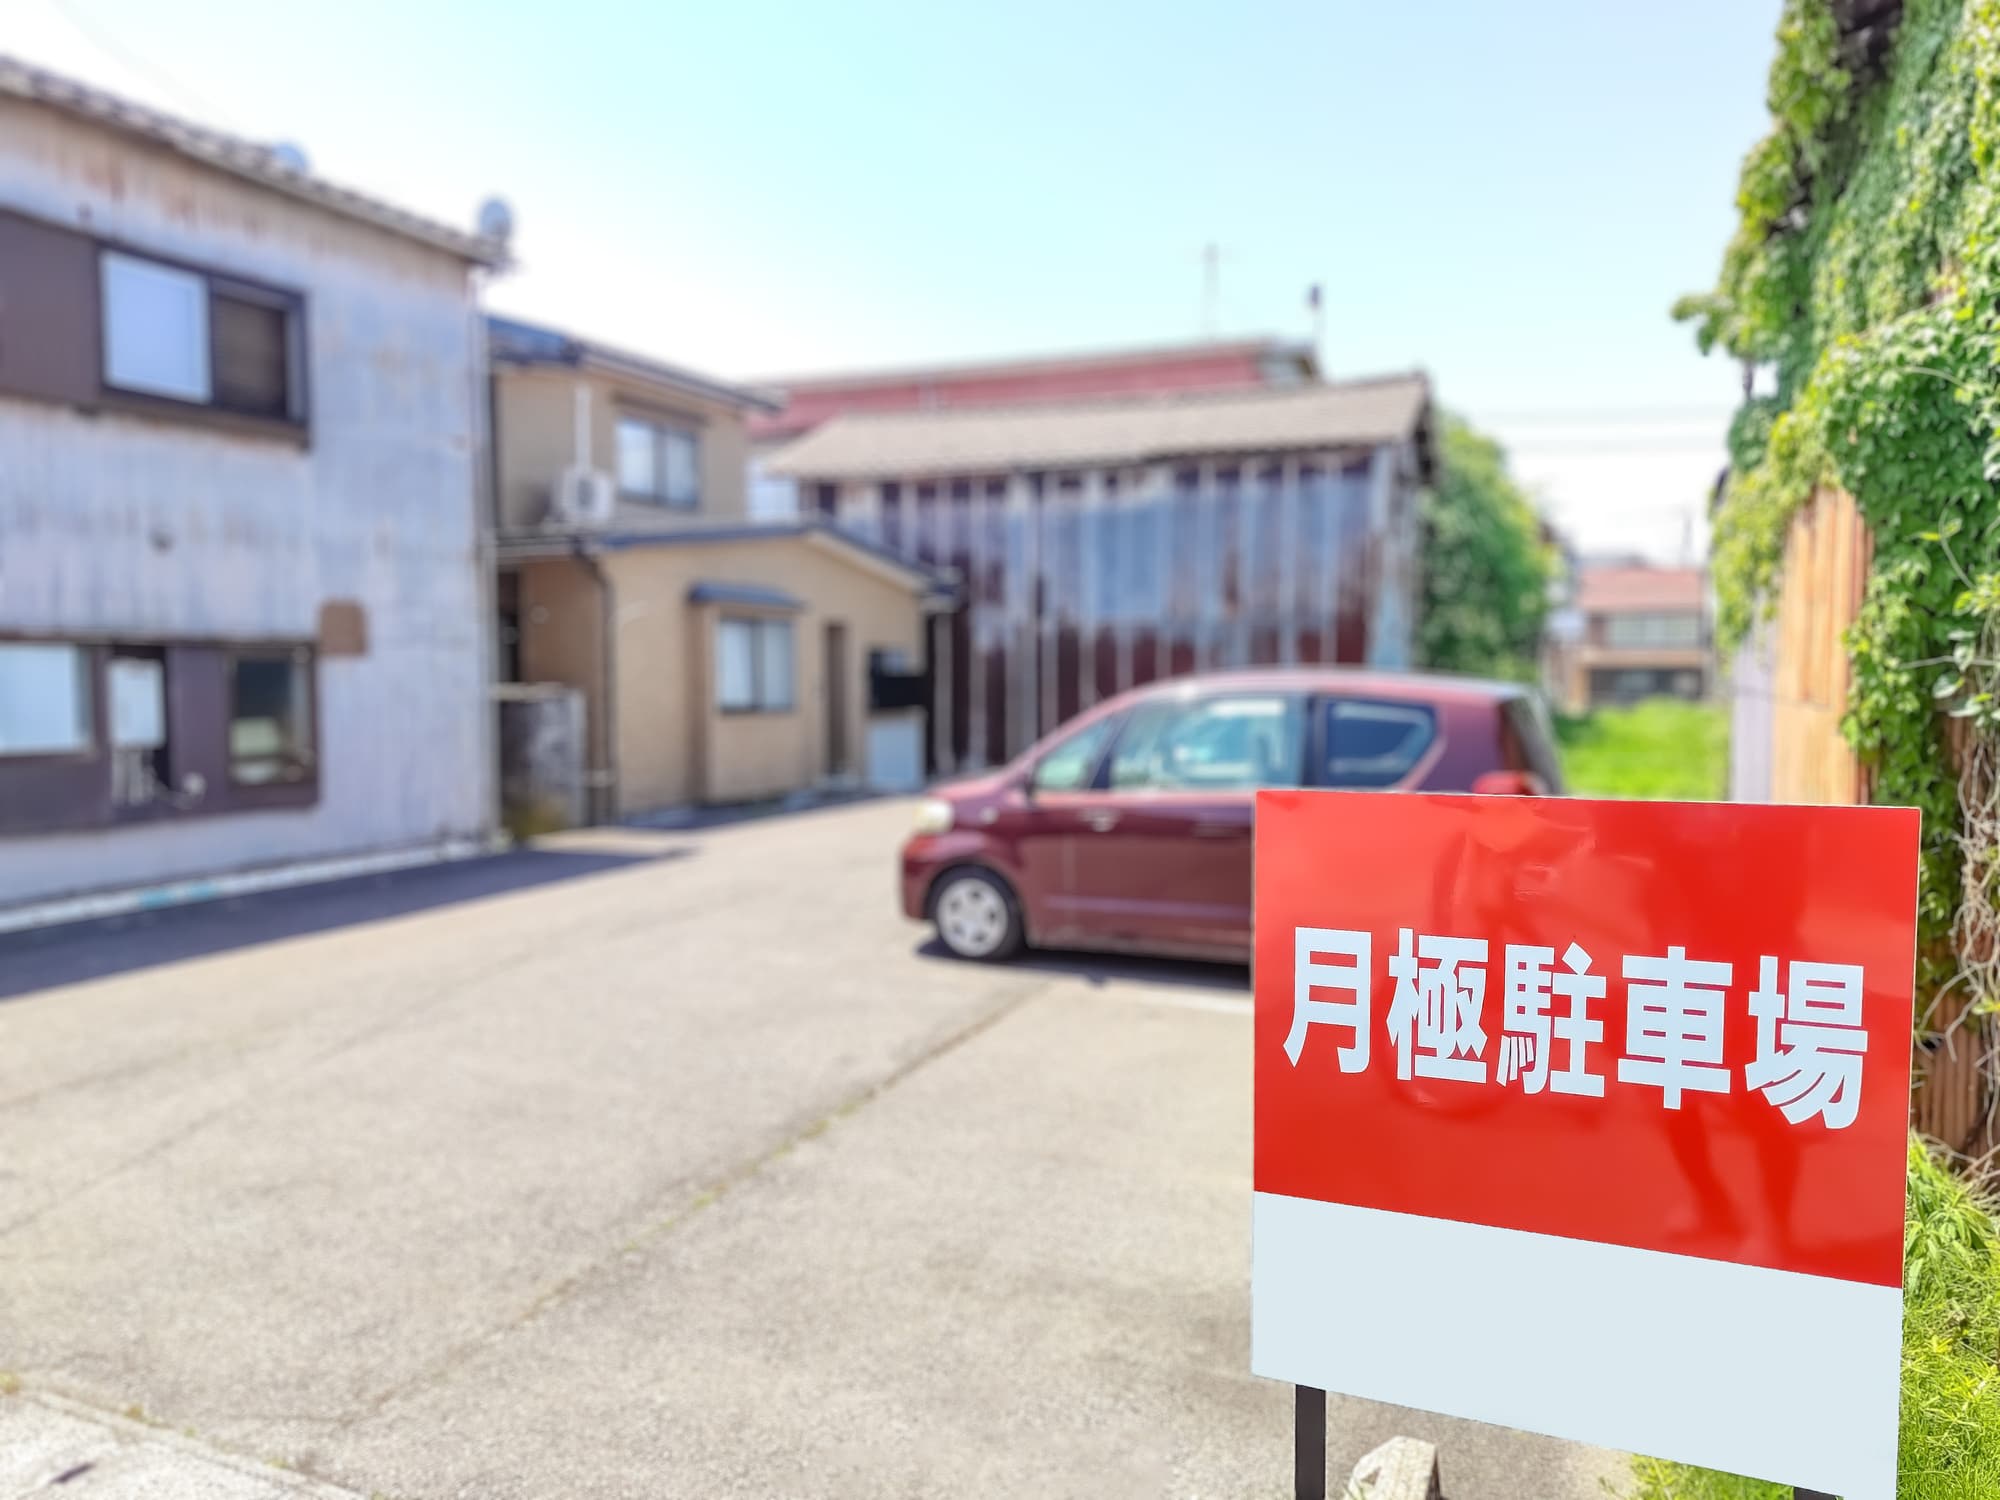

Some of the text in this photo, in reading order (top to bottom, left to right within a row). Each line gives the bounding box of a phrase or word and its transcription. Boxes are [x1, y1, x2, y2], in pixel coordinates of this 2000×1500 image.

[1283, 927, 1868, 1129] 月極駐車場
